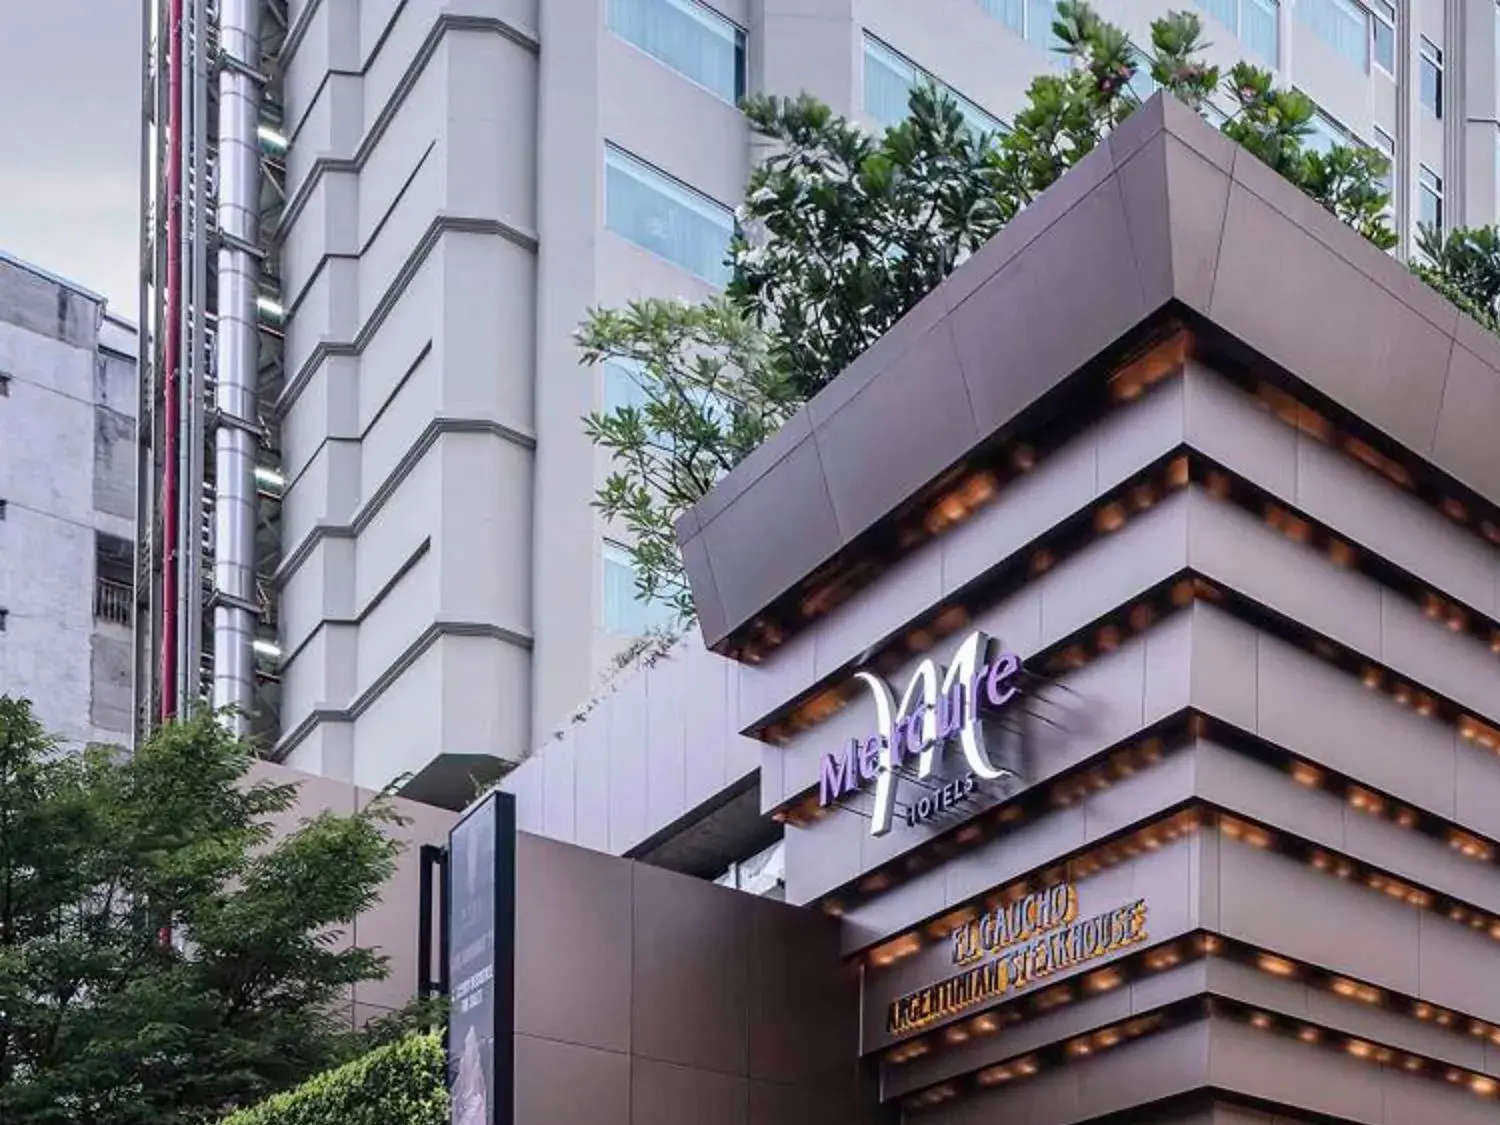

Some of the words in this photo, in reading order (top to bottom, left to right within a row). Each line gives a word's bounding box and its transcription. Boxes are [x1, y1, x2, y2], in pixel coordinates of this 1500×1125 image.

[818, 651, 1023, 807] Mercure
[906, 772, 976, 827] HOTELS
[886, 953, 1008, 1037] ARGENTINIAN
[1003, 897, 1149, 990] STEAKHOUSE
[979, 880, 1079, 953] GAUCHO
